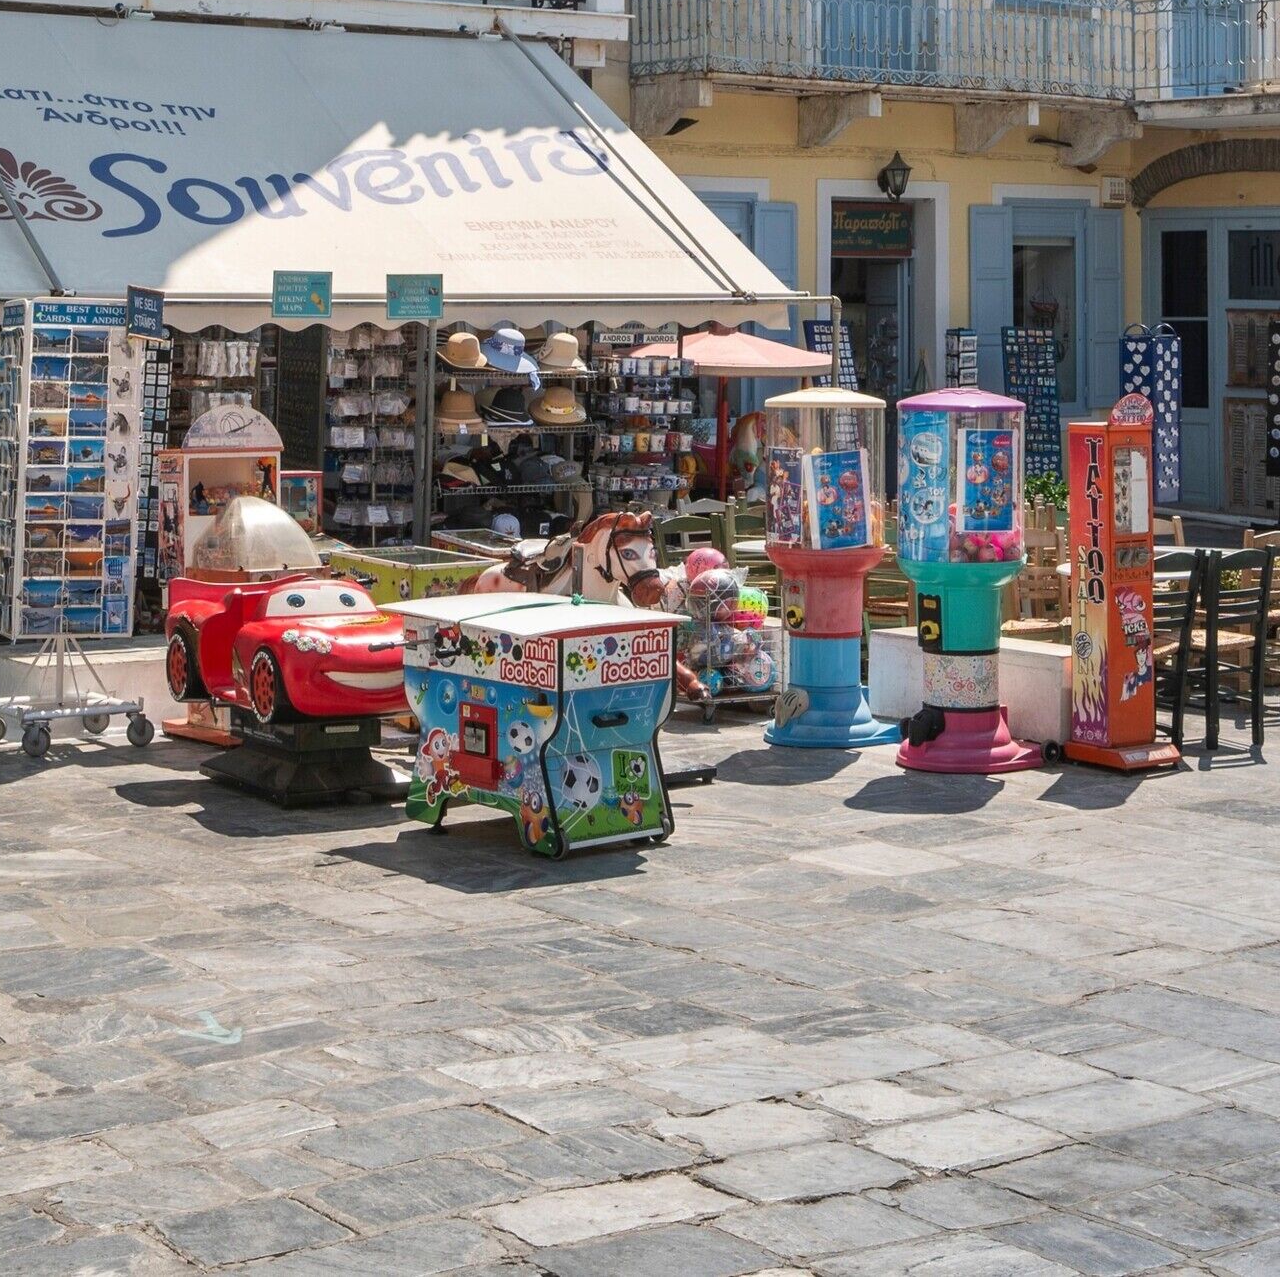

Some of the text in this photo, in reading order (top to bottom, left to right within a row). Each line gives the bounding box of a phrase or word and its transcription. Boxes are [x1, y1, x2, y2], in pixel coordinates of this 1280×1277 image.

[160, 103, 216, 121] την
[89, 130, 611, 238] Souvenirs
[463, 218, 619, 231] ΕΝΘΥΜΙΑ ΑΝΔΡΟΥ
[279, 275, 309, 283] ANDROS
[134, 296, 158, 312] WE SELL
[278, 295, 307, 303] HIKING
[40, 304, 59, 313] THE
[66, 305, 91, 314] BEST
[281, 303, 303, 312] MAPS
[39, 314, 72, 323] CARDS
[77, 315, 88, 323] IN
[134, 313, 157, 330] STAMPS
[602, 334, 631, 342] ANDROS
[646, 334, 674, 342] ANDROS
[1085, 437, 1106, 605] TATTOO
[632, 629, 669, 655] mini
[524, 638, 556, 663] mini
[500, 657, 556, 689] football
[601, 653, 669, 684] football
